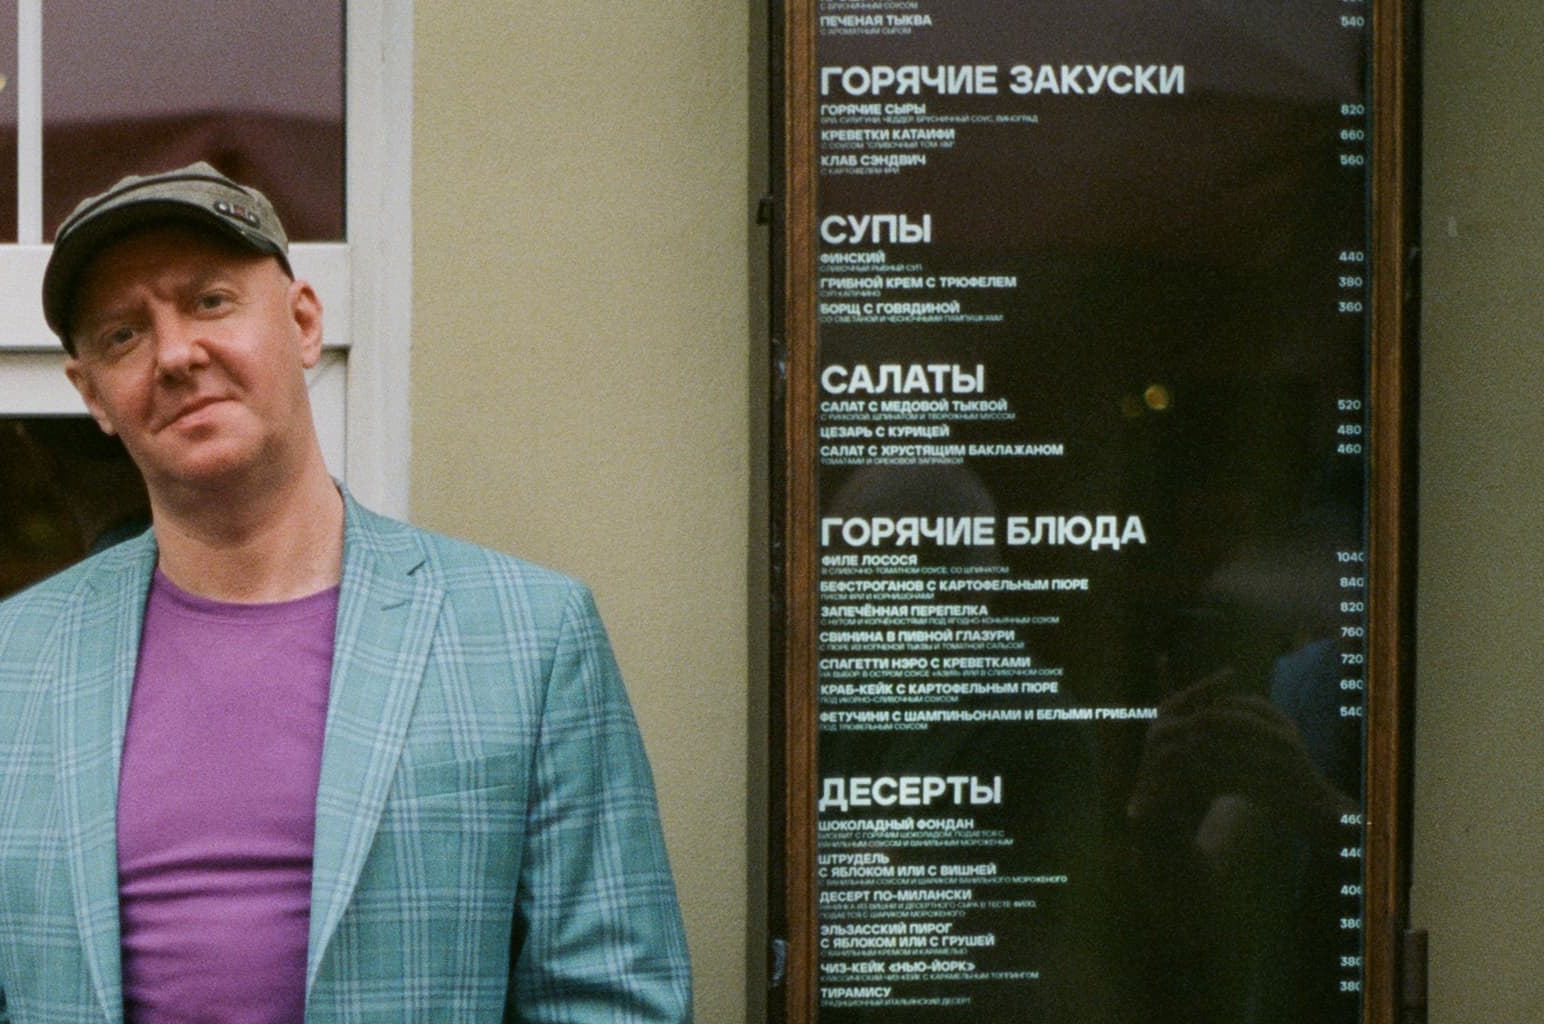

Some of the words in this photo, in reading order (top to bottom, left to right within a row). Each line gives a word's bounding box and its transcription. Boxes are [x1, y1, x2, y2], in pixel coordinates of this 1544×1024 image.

[820, 15, 884, 26] ПЕЧЕНАЯ
[886, 14, 933, 26] ТЫКВА
[1340, 15, 1365, 27] 540
[821, 66, 998, 94] ГОРЯЧИЕ
[1009, 65, 1185, 94] ЗАКУСКИ
[820, 104, 882, 115] ГОРЯЧИЕ
[884, 103, 927, 115] СЫРЫ
[1340, 103, 1365, 115] 820
[821, 129, 890, 141] КРЕВЕТКИ
[1340, 129, 1365, 141] 660
[820, 155, 858, 166] КЛАБ
[859, 154, 927, 168] СЭНДВИЧ
[1339, 154, 1364, 166] 560
[820, 215, 932, 243] СУПЫ
[819, 251, 886, 264] ФИНСКИЙ
[1338, 251, 1364, 262] 440
[820, 276, 884, 289] ГРИБНОЙ
[885, 277, 924, 289] КРЕМ
[925, 276, 936, 288] С
[939, 276, 1017, 288] ТРЮФЕЛЕМ
[1338, 276, 1363, 288] 380
[819, 303, 862, 317] БОРЩ
[862, 303, 874, 315] С
[875, 301, 961, 316] ГОВЯДИНОЙ
[1338, 301, 1363, 313] 360
[821, 365, 985, 393] САЛАТЫ
[820, 401, 866, 412] САЛАТ
[867, 401, 879, 412] С
[880, 398, 950, 415] МЕДОВОЙ
[951, 399, 1008, 412] ТЫКВОЙ
[1337, 399, 1361, 411] 520
[820, 426, 874, 440] ЦЕЗАРЬ
[874, 426, 886, 438] С
[887, 424, 950, 439] КУРИЦЕЙ
[1336, 424, 1362, 435] 480
[819, 445, 865, 457] САЛАТ
[867, 445, 878, 457] С
[880, 444, 967, 459] ХРУСТЯЩИМ
[968, 444, 1064, 455] БАКЛАЖАНОМ
[1337, 443, 1362, 454] 460
[821, 517, 996, 546] ГОРЯЧИЕ
[1007, 517, 1147, 550] БЛЮДА
[821, 555, 859, 566] ФИЛЕ
[861, 554, 918, 566] ЛОСОСЯ
[819, 580, 925, 592] БЕФСТРОГАНОВ
[925, 580, 937, 592] С
[939, 579, 1050, 591] КАРТОФЕЛЬНЫМ
[1051, 578, 1089, 590] ПЮРЕ
[1339, 576, 1364, 588] 840
[910, 604, 989, 617] ПЕРЕПЕЛКА
[1340, 601, 1364, 613] 820
[819, 631, 884, 642] СВИНИНА
[886, 630, 897, 643] В
[897, 629, 954, 642] ПИВНОЙ
[955, 630, 1015, 641] ГЛАЗУРИ
[1341, 626, 1364, 638] 760
[819, 658, 890, 670] СПАГЕТТИ
[929, 657, 940, 669] С
[942, 657, 1031, 668] КРЕВЕТКАМИ
[1341, 653, 1364, 665] 720
[820, 683, 894, 695] КРАБ-КЕЙК
[895, 683, 906, 695] С
[908, 683, 1019, 694] КАРТОФЕЛЬНЫМ
[1021, 681, 1059, 693] ПЮРЕ
[819, 711, 890, 722] ФЕТУЧИНИ
[891, 710, 902, 722] С
[903, 710, 1022, 721] ШАМПИНЬОНАМИ
[1023, 709, 1035, 720] И
[1036, 708, 1094, 720] БЕЛЫМИ
[1094, 708, 1158, 719] ГРИБАМИ
[818, 776, 1002, 812] ДЕСЕРТЫ
[818, 818, 915, 833] ШОКОЛАДНЫЙ
[916, 819, 974, 832] ФОНДАН
[817, 853, 890, 867] ШТРУДЕЛЬ
[818, 867, 828, 878] С
[831, 866, 896, 877] ЯБЛОКОМ
[896, 865, 926, 877] ИЛИ
[927, 865, 937, 876] С
[939, 864, 997, 876] ВИШНЕЙ
[819, 890, 871, 904] ДЕСЕРТ
[873, 890, 972, 901] ПО-МИЛАНСКИ
[821, 923, 908, 935] ЭЛЬЗАССКИЙ
[908, 922, 953, 934] ПИРОГ
[820, 938, 830, 949] С
[832, 937, 897, 948] ЯБЛОКОМ
[898, 936, 928, 947] ИЛИ
[928, 936, 939, 947] С
[941, 934, 995, 946] ГРУШЕЙ
[820, 961, 886, 973] ЧИЗ-КЕЙК
[820, 987, 892, 998] ТИРАМИСУ
